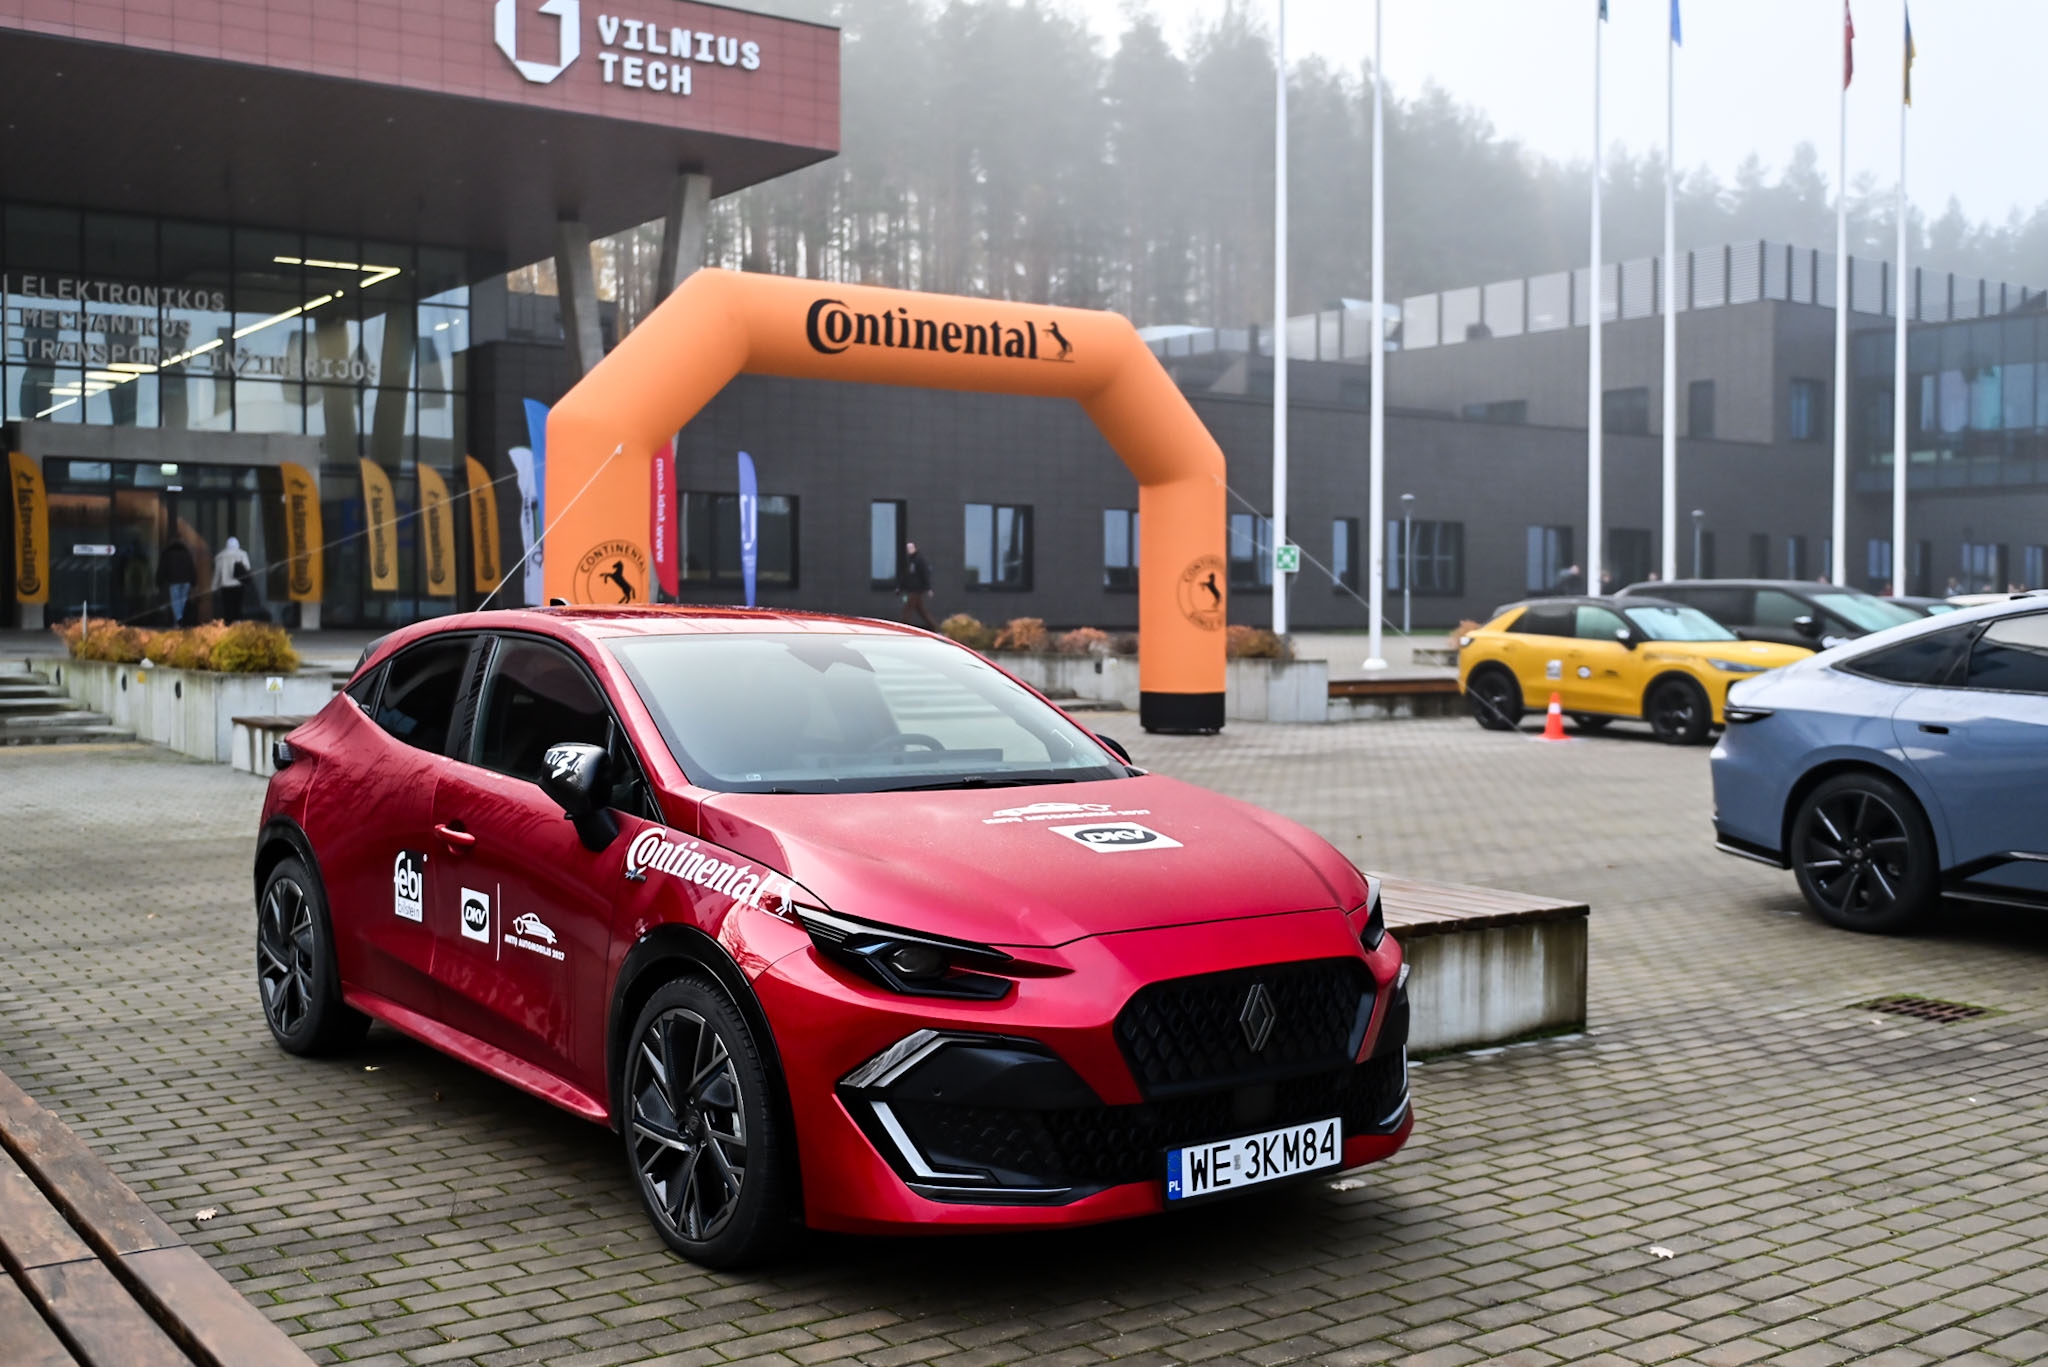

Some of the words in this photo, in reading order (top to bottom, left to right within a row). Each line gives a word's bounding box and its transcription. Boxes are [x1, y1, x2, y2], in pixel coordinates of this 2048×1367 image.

[597, 14, 761, 71] VILNIUS
[597, 52, 693, 96] TECH
[22, 274, 226, 313] ELEKTRONIKOS
[21, 306, 192, 339] MECHANIKOS
[806, 298, 1039, 360] Continental
[1084, 829, 1146, 843] DKV
[393, 850, 423, 901] febi
[627, 826, 774, 909] Continental
[397, 896, 421, 919] bilstein
[465, 904, 488, 926] DKV
[1189, 1144, 1232, 1192] WE
[1244, 1122, 1336, 1180] 3KM84
[1168, 1180, 1181, 1193] PL
